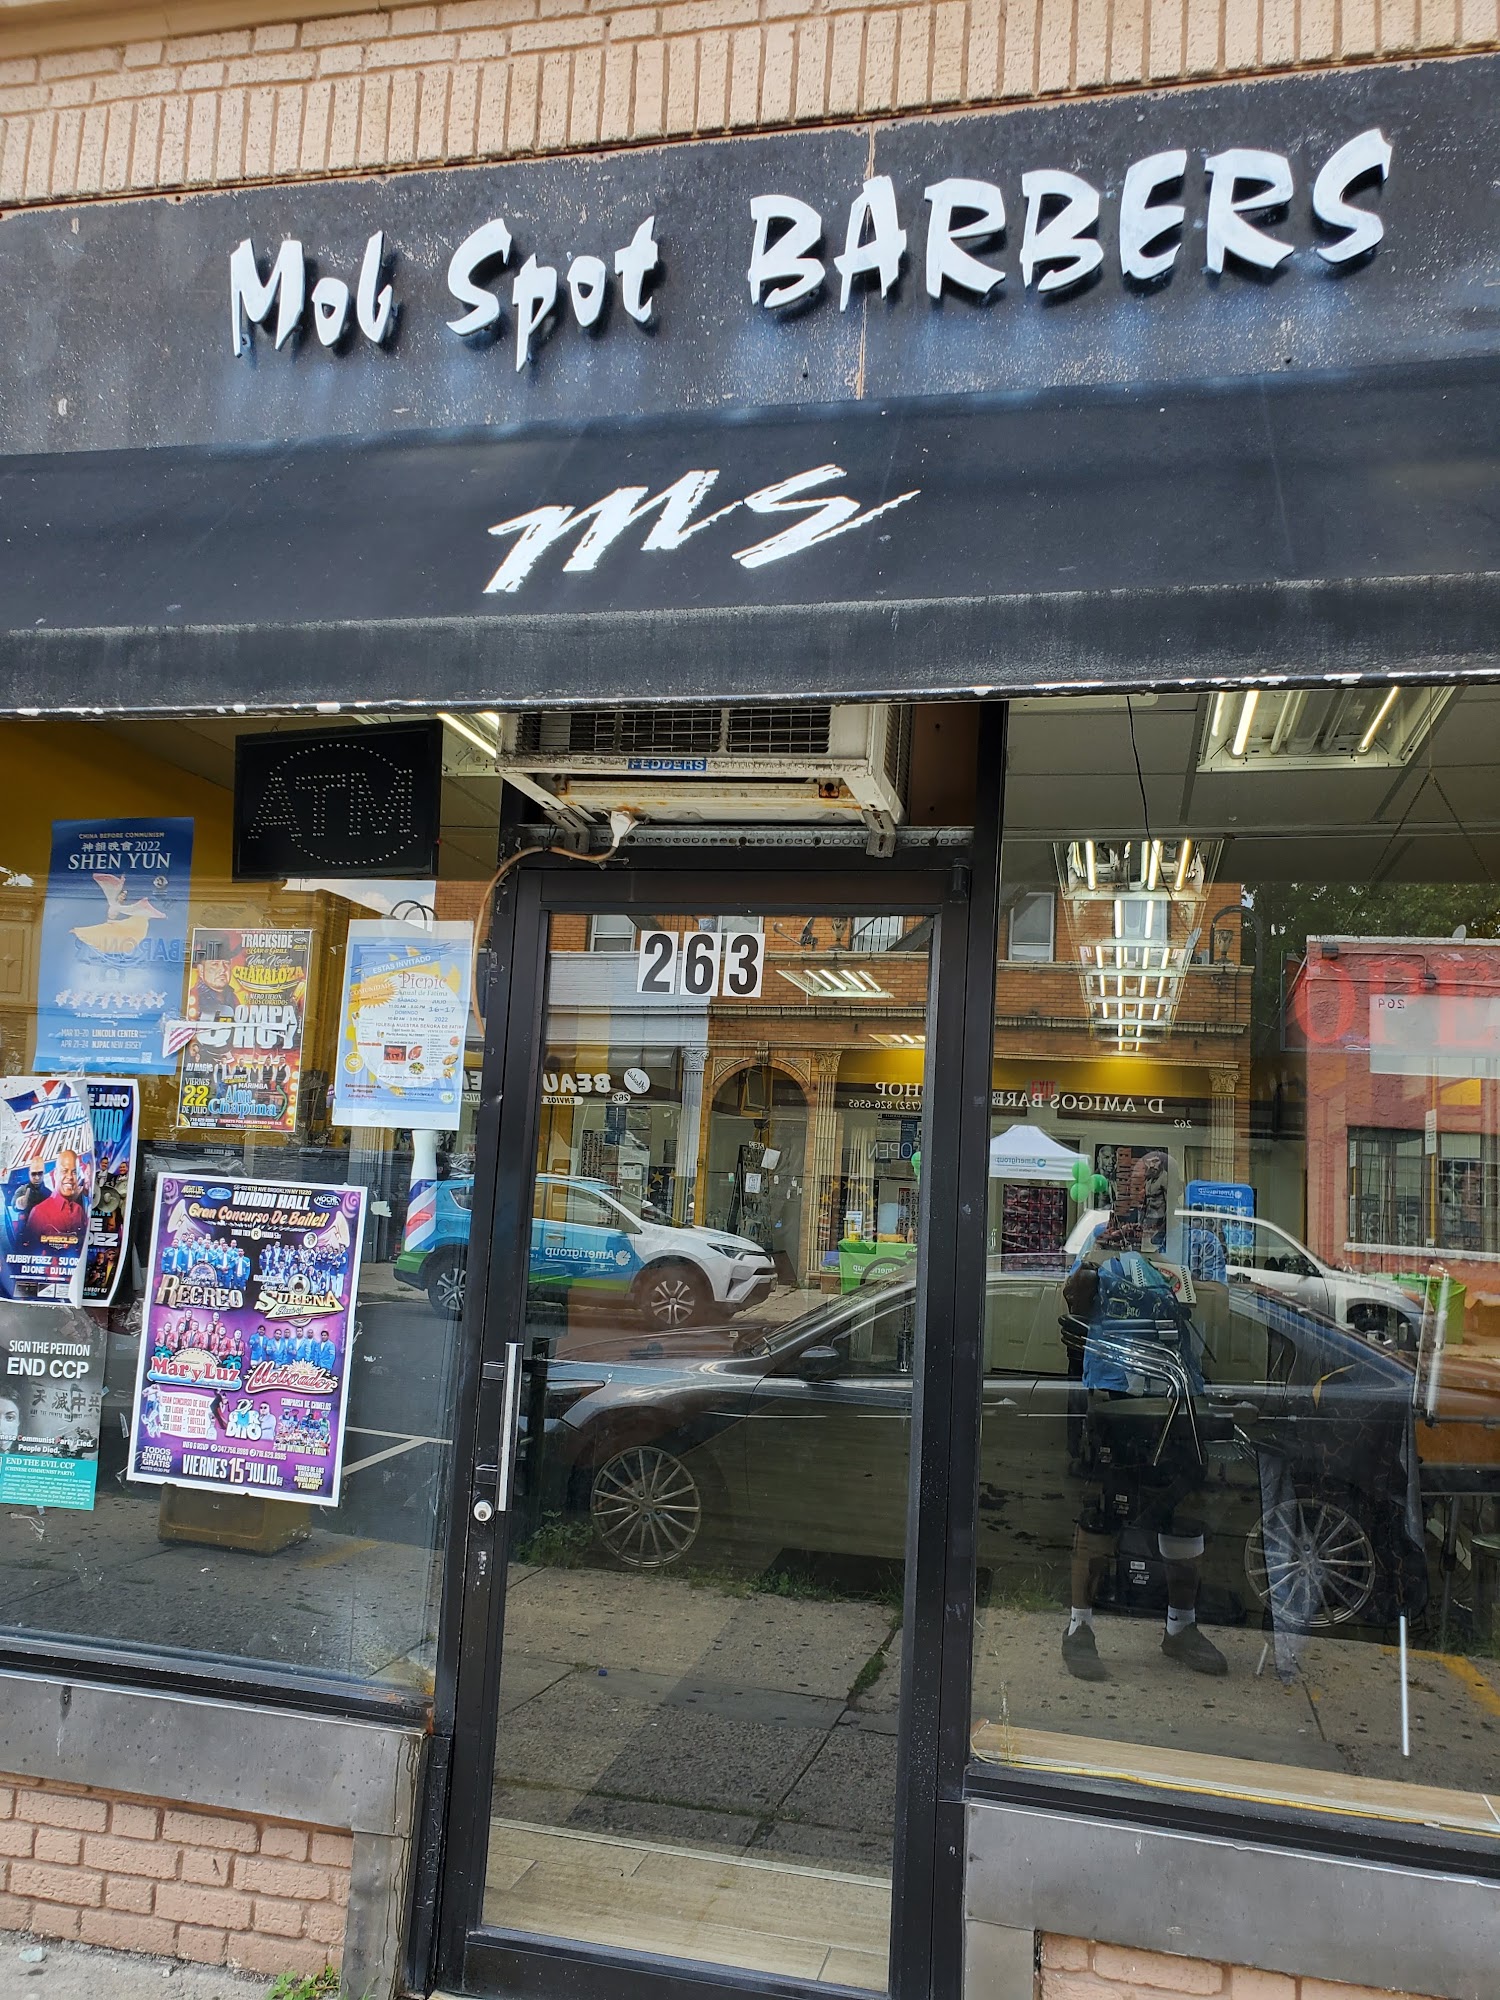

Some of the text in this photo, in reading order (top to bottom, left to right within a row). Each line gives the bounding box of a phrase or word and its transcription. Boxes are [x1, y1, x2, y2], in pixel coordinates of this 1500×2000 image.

[229, 128, 1392, 372] Mob Spot BARBERS
[630, 759, 704, 770] FEDDERS
[247, 769, 418, 842] ATM
[135, 841, 160, 851] 2022
[68, 852, 171, 870] SHEN YUN
[241, 933, 293, 948] TRACKSIDE
[372, 955, 431, 974] ESTAS INVITADO
[642, 931, 761, 996] 263
[61, 1029, 75, 1037] MAR
[92, 1029, 116, 1037] LINCOLN
[117, 1029, 139, 1038] CENTER
[61, 1040, 142, 1049] APR NJPAC NEW JERSEY
[185, 1078, 210, 1086] VIERNES
[95, 1093, 130, 1108] JUNIO
[182, 1085, 209, 1107] 22
[225, 1084, 252, 1103] Alma
[190, 1106, 208, 1115] JULIO
[207, 1098, 277, 1120] Chapina
[232, 1191, 275, 1206] WIDDI
[276, 1194, 310, 1211] HALL
[189, 1203, 217, 1219] Gran
[218, 1206, 269, 1224] Concurso
[270, 1209, 287, 1225] De
[288, 1211, 330, 1228] Baile!!
[6, 1254, 32, 1264] RUBBY
[32, 1255, 52, 1265] PEREZ
[21, 1265, 30, 1273] DJ
[30, 1266, 45, 1275] ONE
[50, 1266, 59, 1275] DJ
[154, 1273, 243, 1308] RECREO
[9, 1340, 90, 1356] SIGN THE PETITION
[7, 1357, 89, 1379] END CCP
[152, 1357, 239, 1382] Mar y Luz
[245, 1360, 338, 1393] Motivador
[17, 1434, 55, 1444] Communist
[55, 1436, 75, 1447] Party
[76, 1440, 93, 1448] Lied.
[18, 1444, 60, 1454] People Died.
[143, 1446, 171, 1455] TODOS
[6, 1457, 76, 1469] END THE EVIL CCP
[141, 1453, 172, 1462] ENTRAN
[142, 1458, 171, 1469] GRATIS
[28, 1467, 57, 1475] COMMUNIST
[182, 1454, 228, 1479] VIERNES
[228, 1457, 246, 1484] 15
[247, 1462, 278, 1486] JULIO
